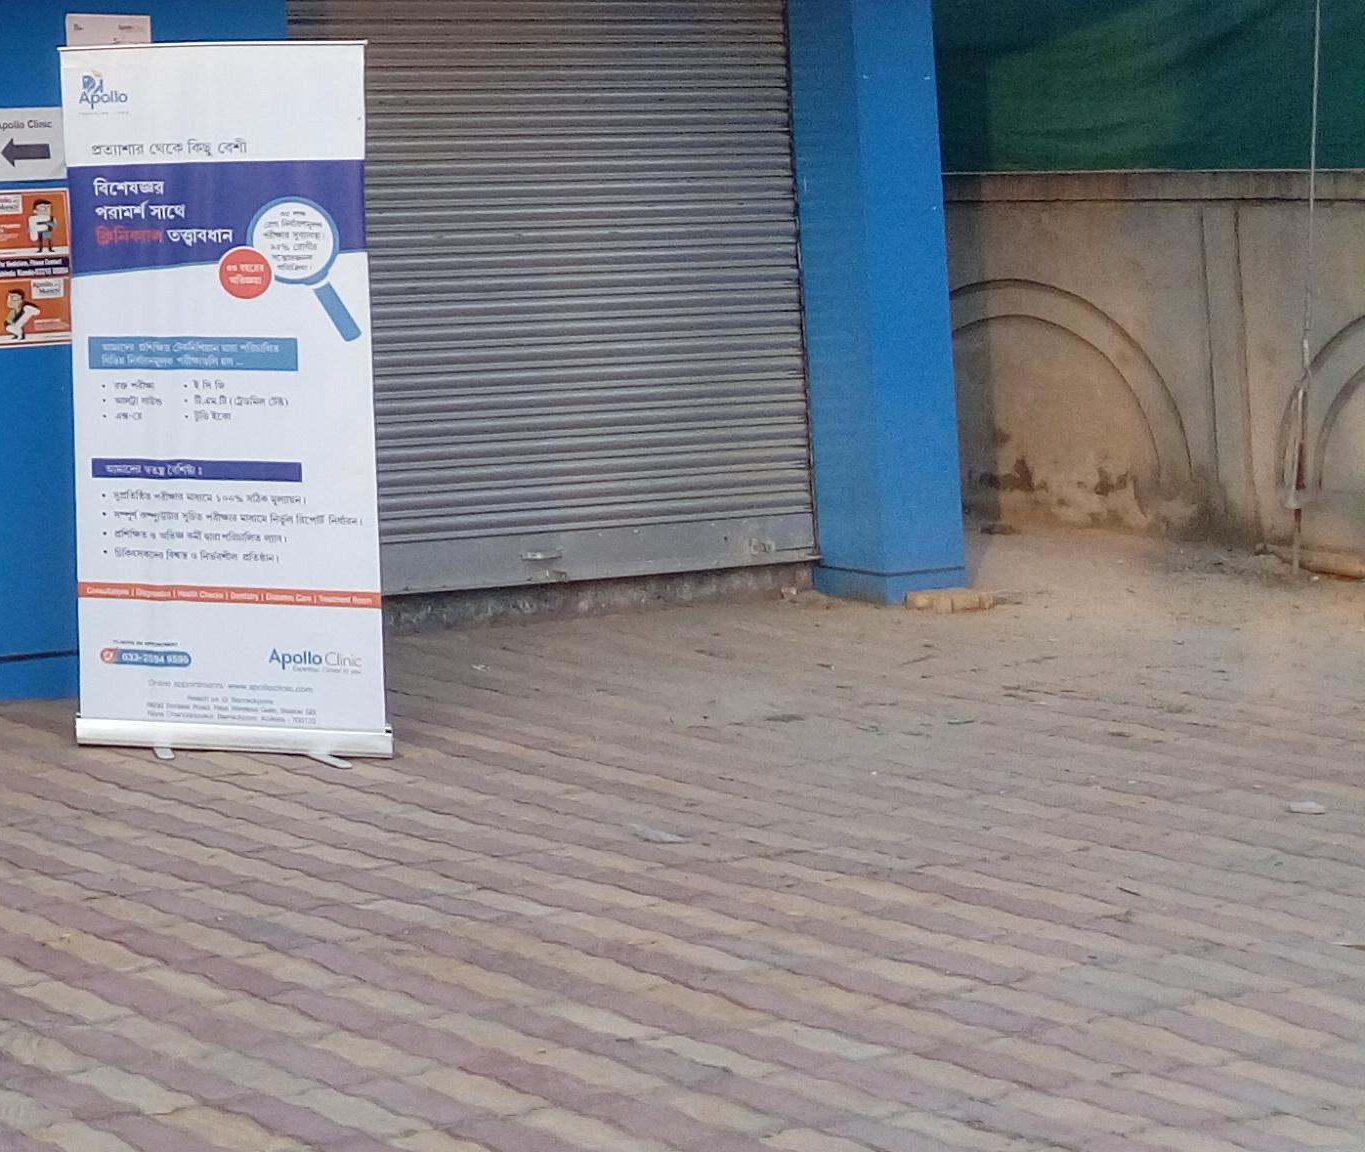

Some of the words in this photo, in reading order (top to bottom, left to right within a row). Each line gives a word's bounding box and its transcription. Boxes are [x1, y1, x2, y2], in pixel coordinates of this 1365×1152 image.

[78, 90, 128, 109] Apollo
[27, 120, 52, 129] Clinic
[95, 199, 149, 220] পরামর্শ
[149, 204, 185, 220] সাথে
[269, 648, 322, 670] Apollo
[325, 652, 362, 667] Clinic
